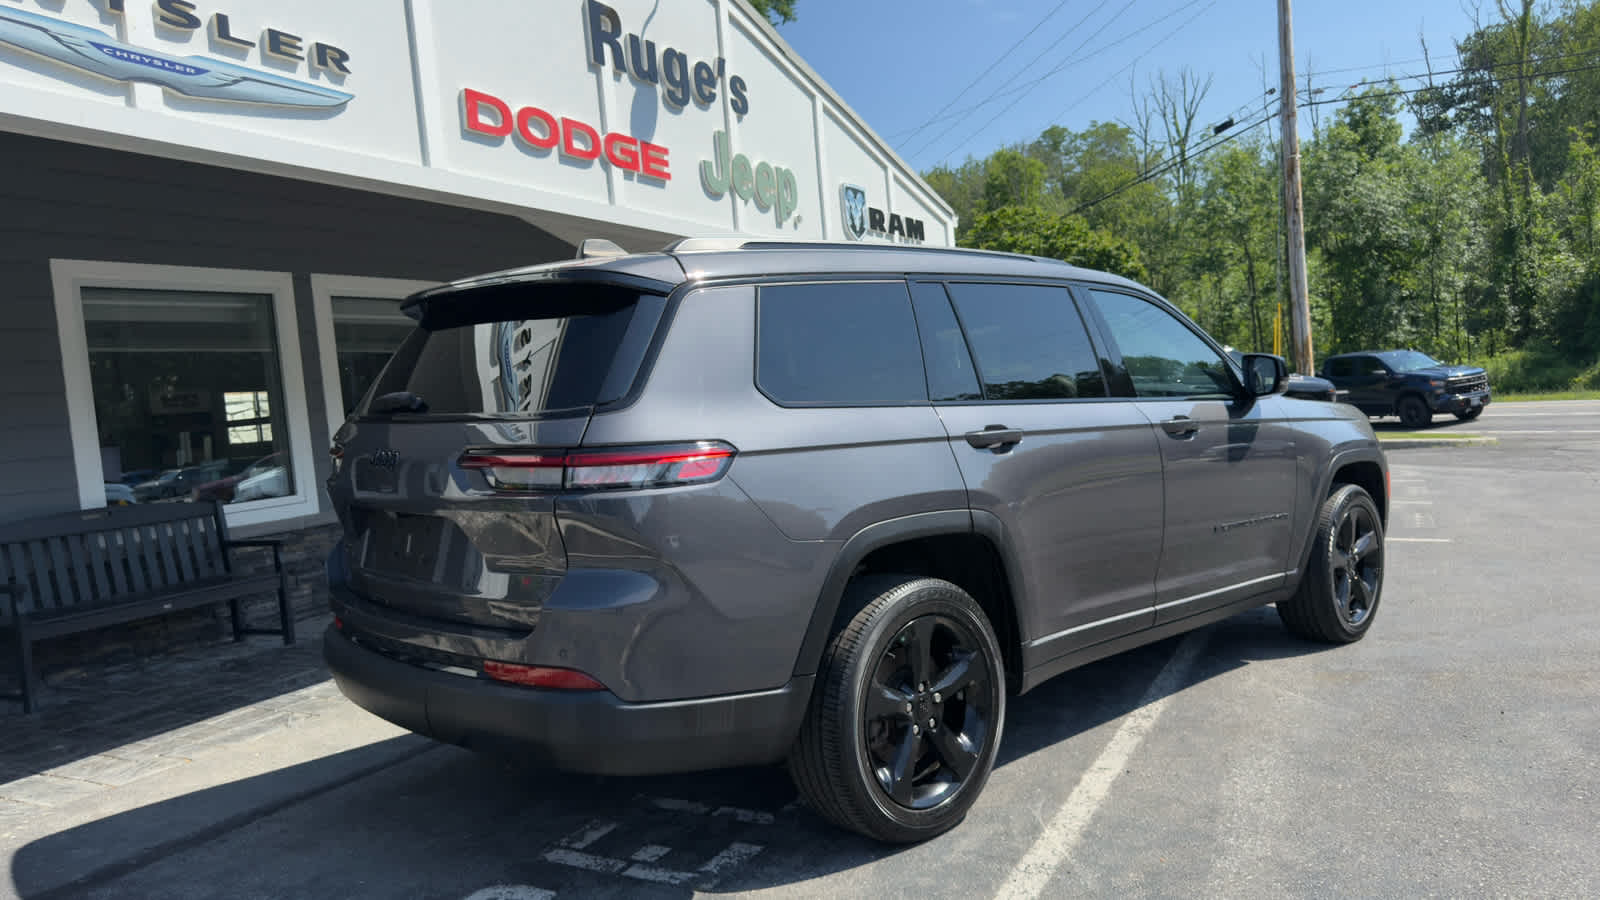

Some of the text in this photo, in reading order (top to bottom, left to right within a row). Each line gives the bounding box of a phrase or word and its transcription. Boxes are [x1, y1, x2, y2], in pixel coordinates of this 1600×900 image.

[103, 48, 197, 75] CHRYSLER
[109, 0, 352, 74] SLER
[586, 0, 749, 115] Ruge's
[463, 87, 672, 181] DODGE
[867, 207, 926, 242] RAM
